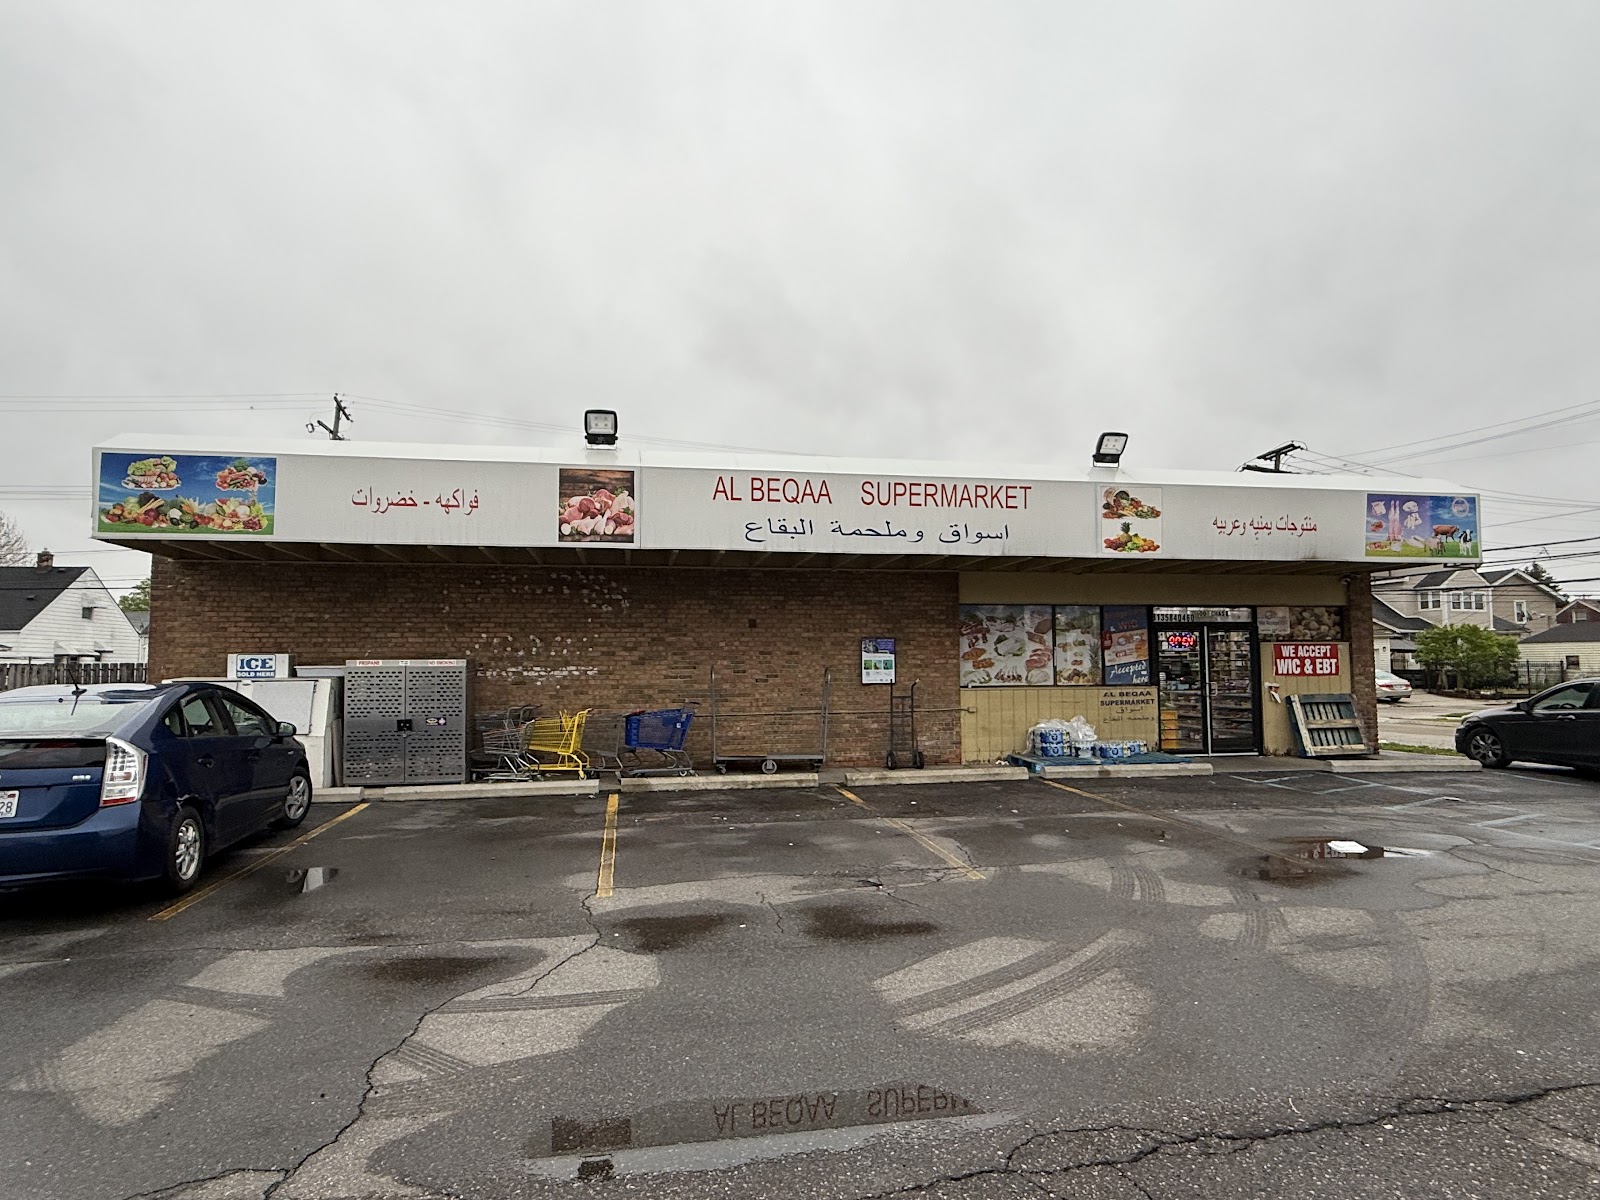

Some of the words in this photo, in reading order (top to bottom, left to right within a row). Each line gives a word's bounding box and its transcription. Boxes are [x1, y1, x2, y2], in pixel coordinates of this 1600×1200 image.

[351, 486, 418, 514] خضروات
[713, 476, 742, 502] AL
[750, 477, 832, 504] BEQAA
[861, 480, 1032, 509] SUPERMARKET
[744, 517, 814, 543] البقاع
[938, 523, 1010, 545] اسواق
[1168, 635, 1194, 646] OPEN
[1280, 645, 1295, 658] WE
[1297, 645, 1331, 658] ACCEPT
[239, 657, 273, 670] ICE
[1110, 661, 1147, 678] Accepted
[1276, 658, 1301, 675] WIC
[1304, 658, 1313, 675] &
[1316, 658, 1337, 675] EBT
[1132, 674, 1149, 684] here
